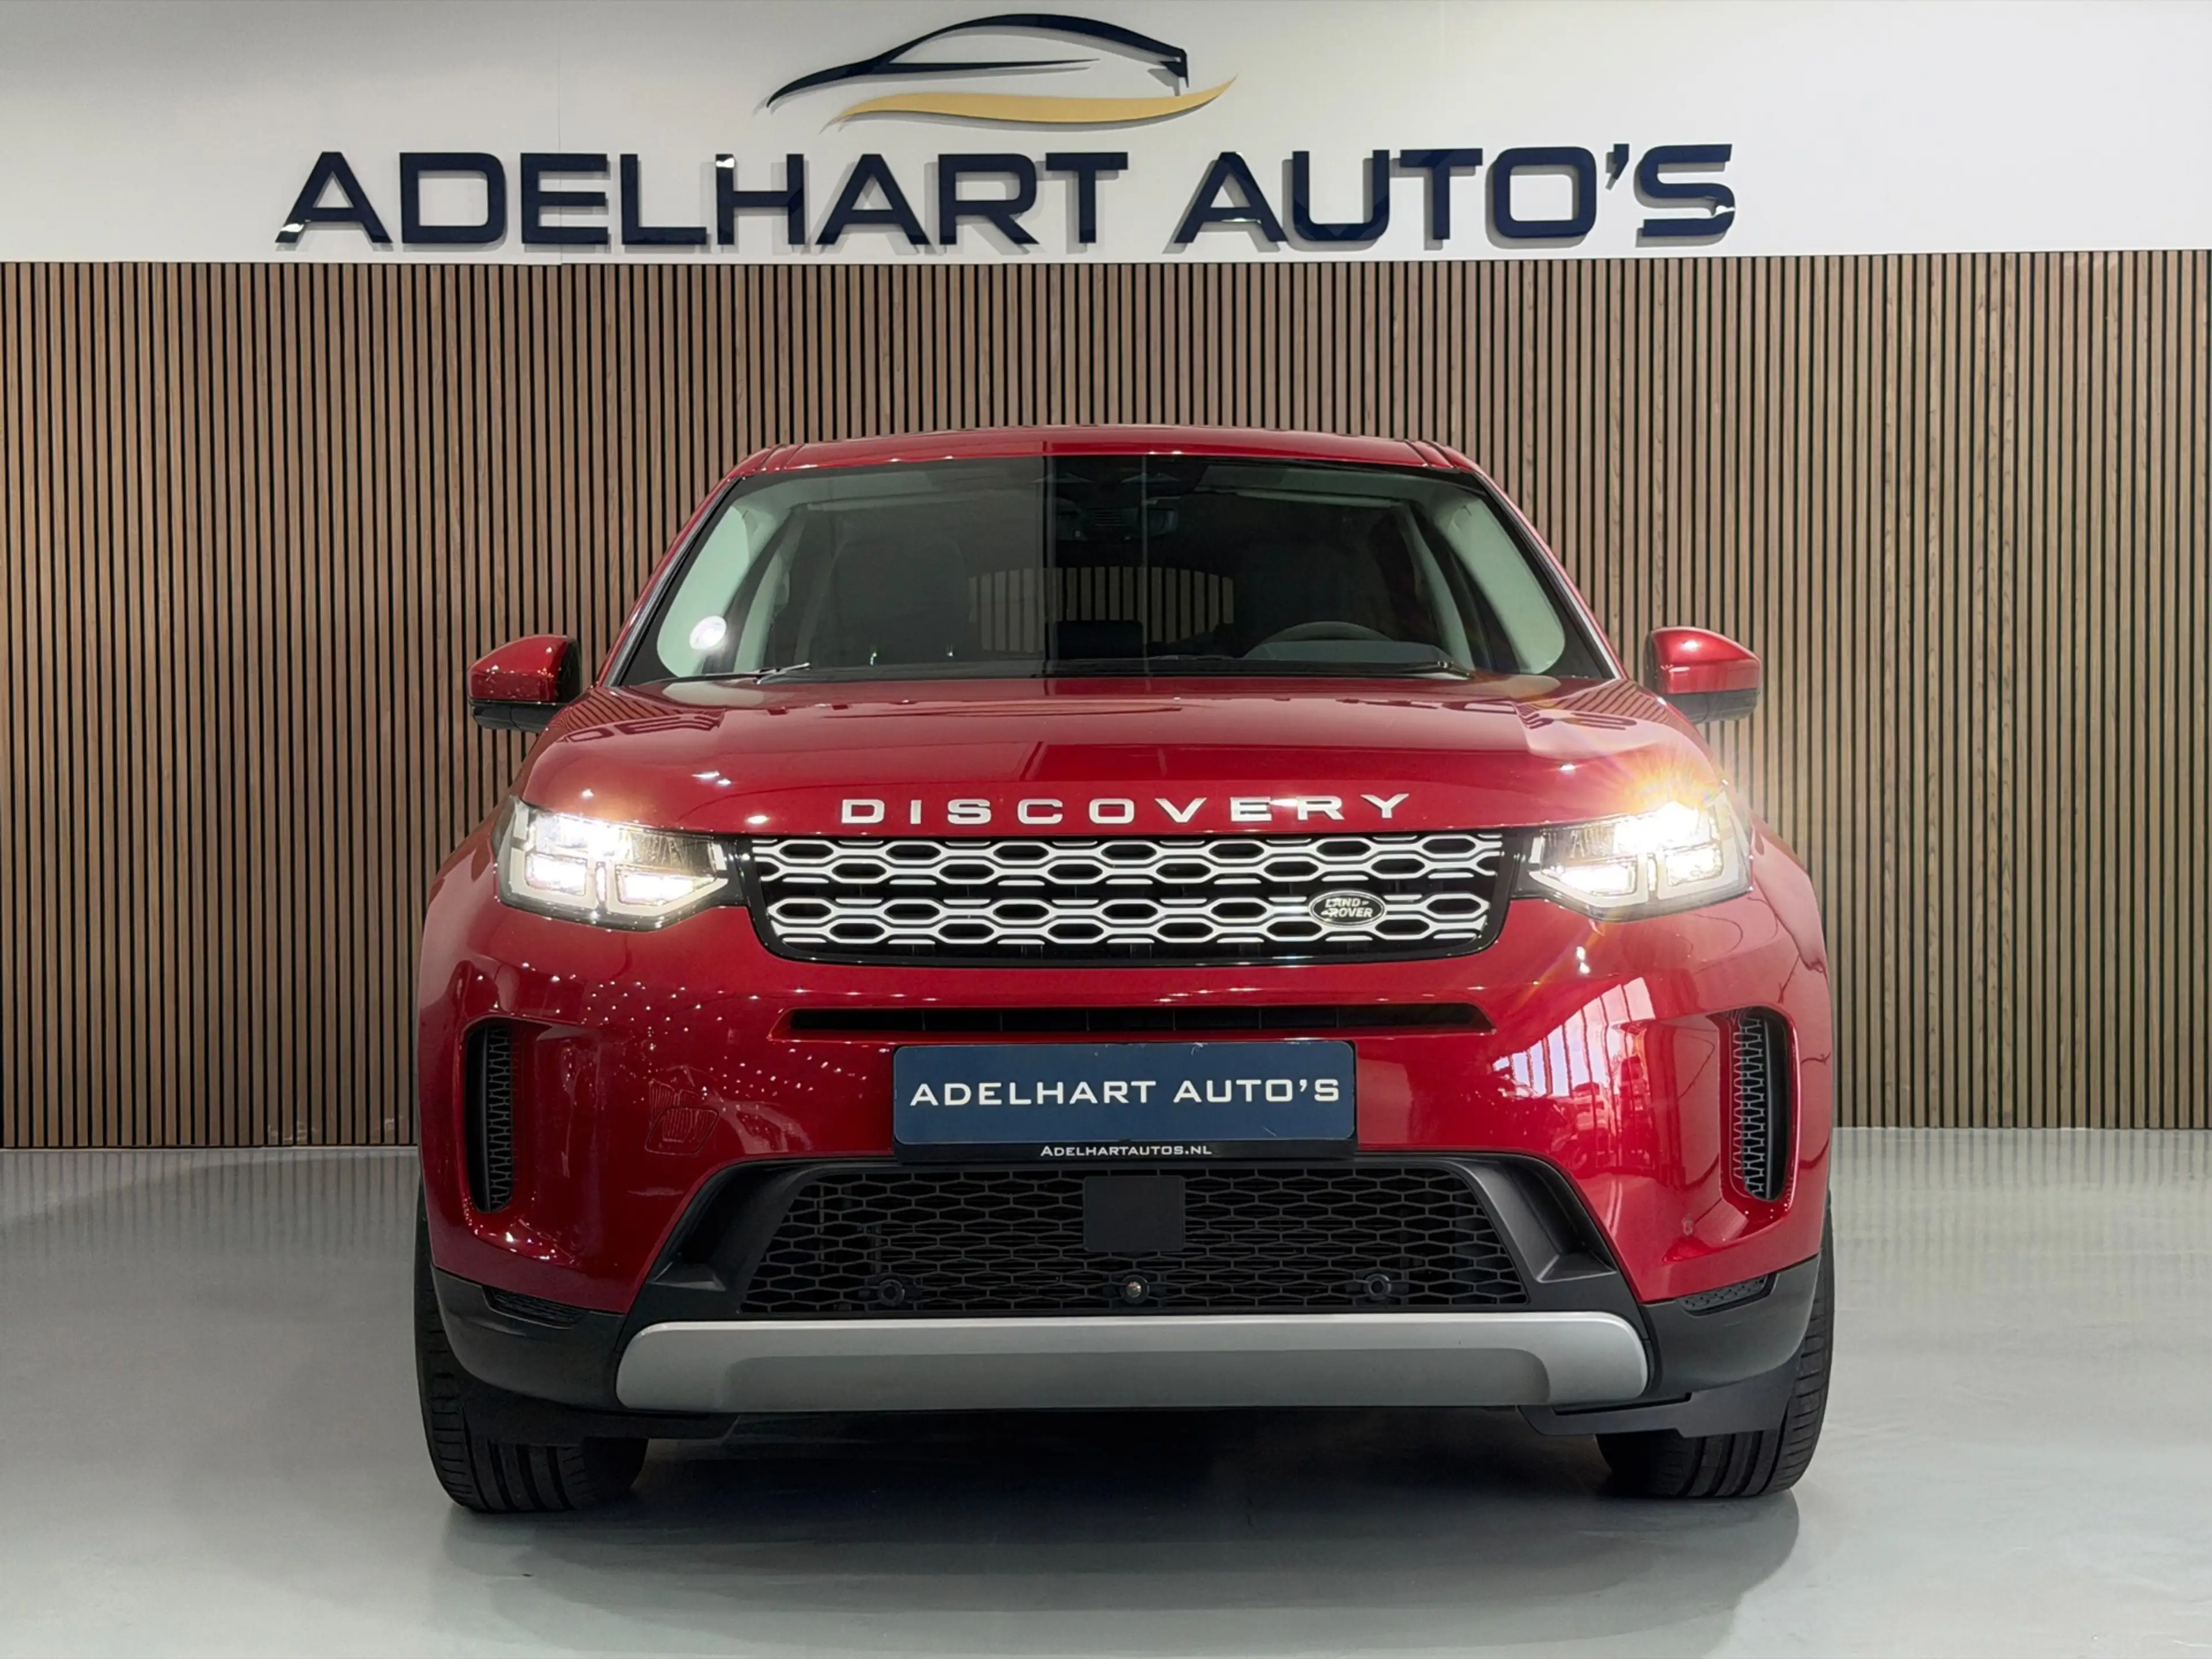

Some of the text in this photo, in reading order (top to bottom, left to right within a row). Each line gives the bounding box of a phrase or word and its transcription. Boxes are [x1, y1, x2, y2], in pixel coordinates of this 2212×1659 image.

[276, 145, 1734, 246] ADELHART AUTO'S
[840, 793, 1410, 824] DISCOVERY
[1325, 897, 1361, 908] LAND
[1326, 907, 1373, 918] ROVER
[910, 1079, 1339, 1106] ADELHART AUTO'S
